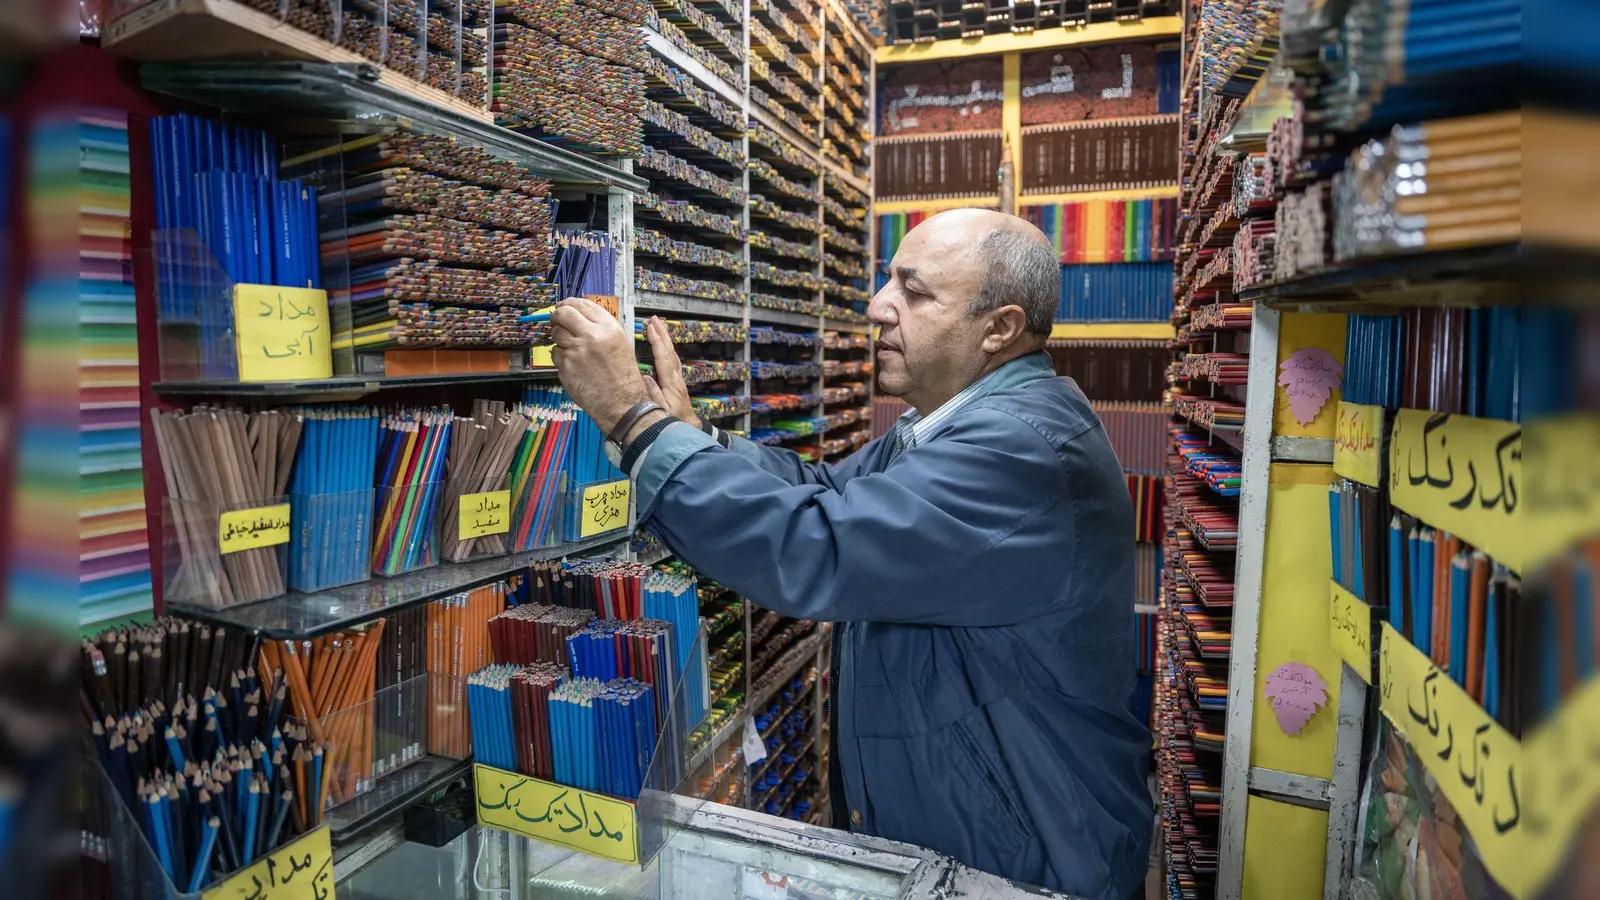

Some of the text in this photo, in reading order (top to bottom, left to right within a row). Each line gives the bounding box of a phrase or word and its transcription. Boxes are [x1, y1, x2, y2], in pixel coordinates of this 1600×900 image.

[258, 292, 316, 321] مداد
[262, 323, 320, 359] آبی
[475, 496, 501, 513] مداد
[585, 484, 627, 509] مداد چرب
[472, 514, 500, 534] سفید
[594, 505, 620, 527] هنری
[558, 792, 624, 842] مداد
